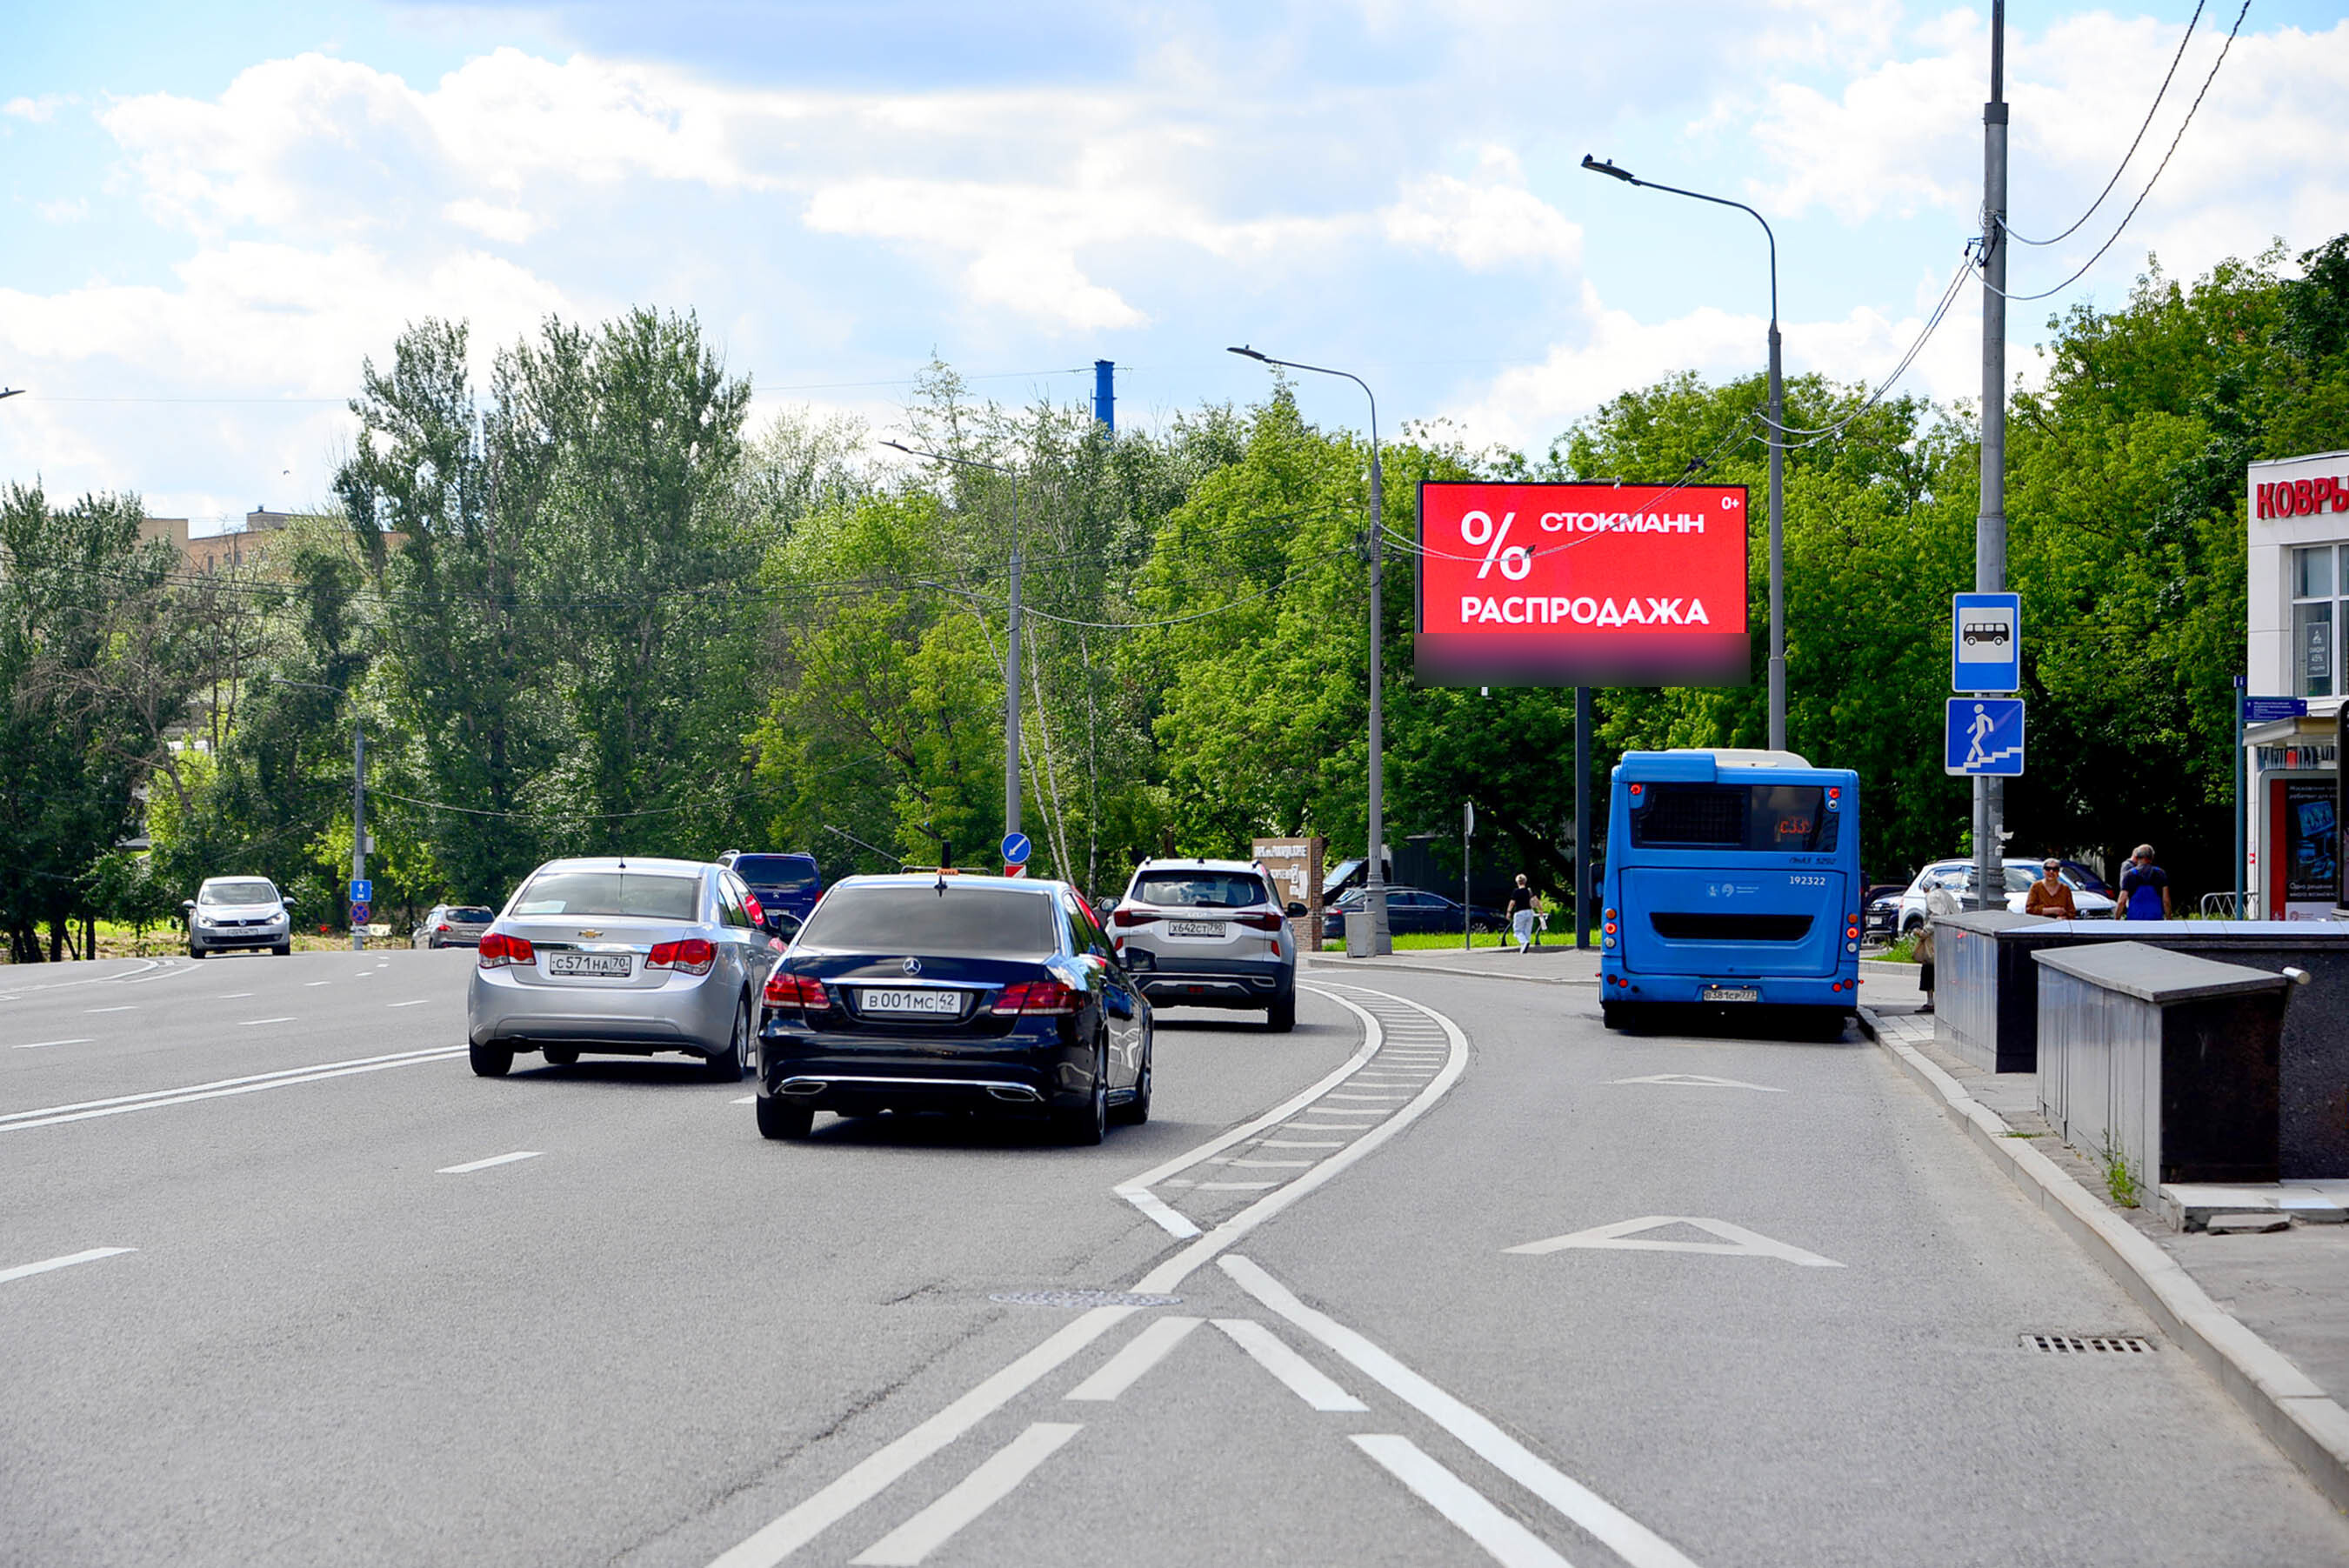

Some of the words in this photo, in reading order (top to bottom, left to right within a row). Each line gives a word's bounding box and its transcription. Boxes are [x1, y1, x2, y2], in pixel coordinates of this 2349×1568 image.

[1721, 497, 1739, 510] 0+
[1540, 512, 1705, 534] СТОКМАНН
[1460, 597, 1710, 627] РАСПРОДАЖА
[1789, 876, 1826, 886] 192322
